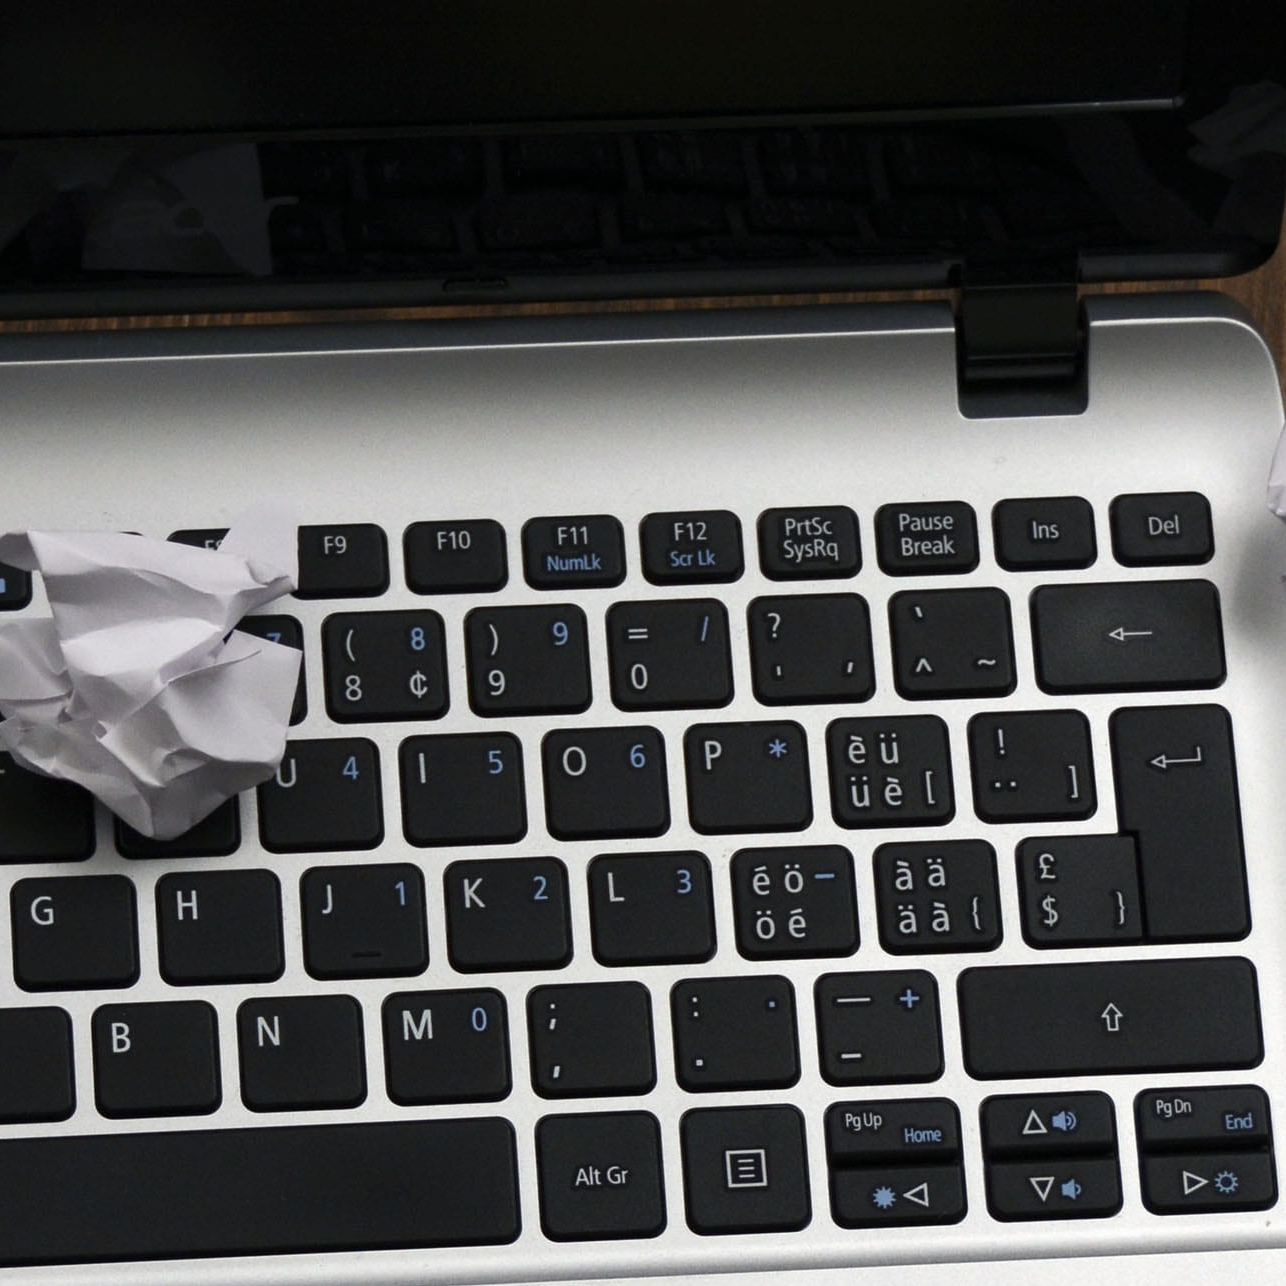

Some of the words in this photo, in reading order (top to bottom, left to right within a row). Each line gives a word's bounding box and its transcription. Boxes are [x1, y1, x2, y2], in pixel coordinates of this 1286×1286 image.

[557, 525, 588, 546] F11
[674, 521, 707, 541] F12
[784, 516, 834, 537] PrtSc
[898, 513, 955, 532] Pause
[1032, 520, 1060, 539] Ins
[1148, 514, 1180, 536] Del
[323, 535, 347, 555] F9
[437, 530, 471, 550] F10
[782, 538, 840, 563] SysRq
[900, 535, 956, 557] Break
[546, 553, 602, 571] NumLk
[669, 550, 693, 568] Scr
[697, 548, 717, 567] Lk
[410, 626, 426, 651] 8
[552, 621, 569, 646] 9
[345, 674, 363, 701] 8
[488, 669, 506, 696] 9
[630, 663, 648, 690] 0
[562, 746, 587, 777] O
[630, 743, 646, 769] 6
[704, 740, 722, 771] P
[848, 735, 866, 764] è
[879, 732, 899, 765] ü
[275, 757, 297, 788] U
[342, 756, 360, 780] 4
[488, 750, 504, 775] 5
[850, 775, 870, 808] ü
[884, 776, 903, 806] è
[895, 860, 914, 891] à
[926, 858, 946, 887] ä
[1038, 853, 1057, 879] £
[463, 877, 486, 909] K
[533, 875, 549, 901] 2
[607, 871, 626, 903] L
[676, 869, 692, 894] 3
[752, 865, 771, 896] é
[783, 863, 804, 894] ö
[30, 895, 55, 926] G
[176, 889, 199, 921] H
[320, 884, 334, 915] J
[394, 881, 407, 906] 1
[1042, 895, 1059, 927] $
[755, 909, 776, 940] ö
[788, 907, 807, 938] é
[897, 904, 917, 934] ä
[931, 901, 950, 932] à
[256, 1015, 281, 1047] N
[402, 1008, 434, 1041] M
[471, 1007, 488, 1032] 0
[111, 1022, 131, 1054] B
[1155, 1099, 1172, 1118] Pg
[1173, 1098, 1193, 1114] Dn
[1225, 1112, 1254, 1130] End
[844, 1112, 862, 1132] Pg
[863, 1111, 884, 1129] Up
[904, 1127, 942, 1143] Home
[574, 1165, 603, 1187] Alt
[606, 1165, 629, 1185] Gr
